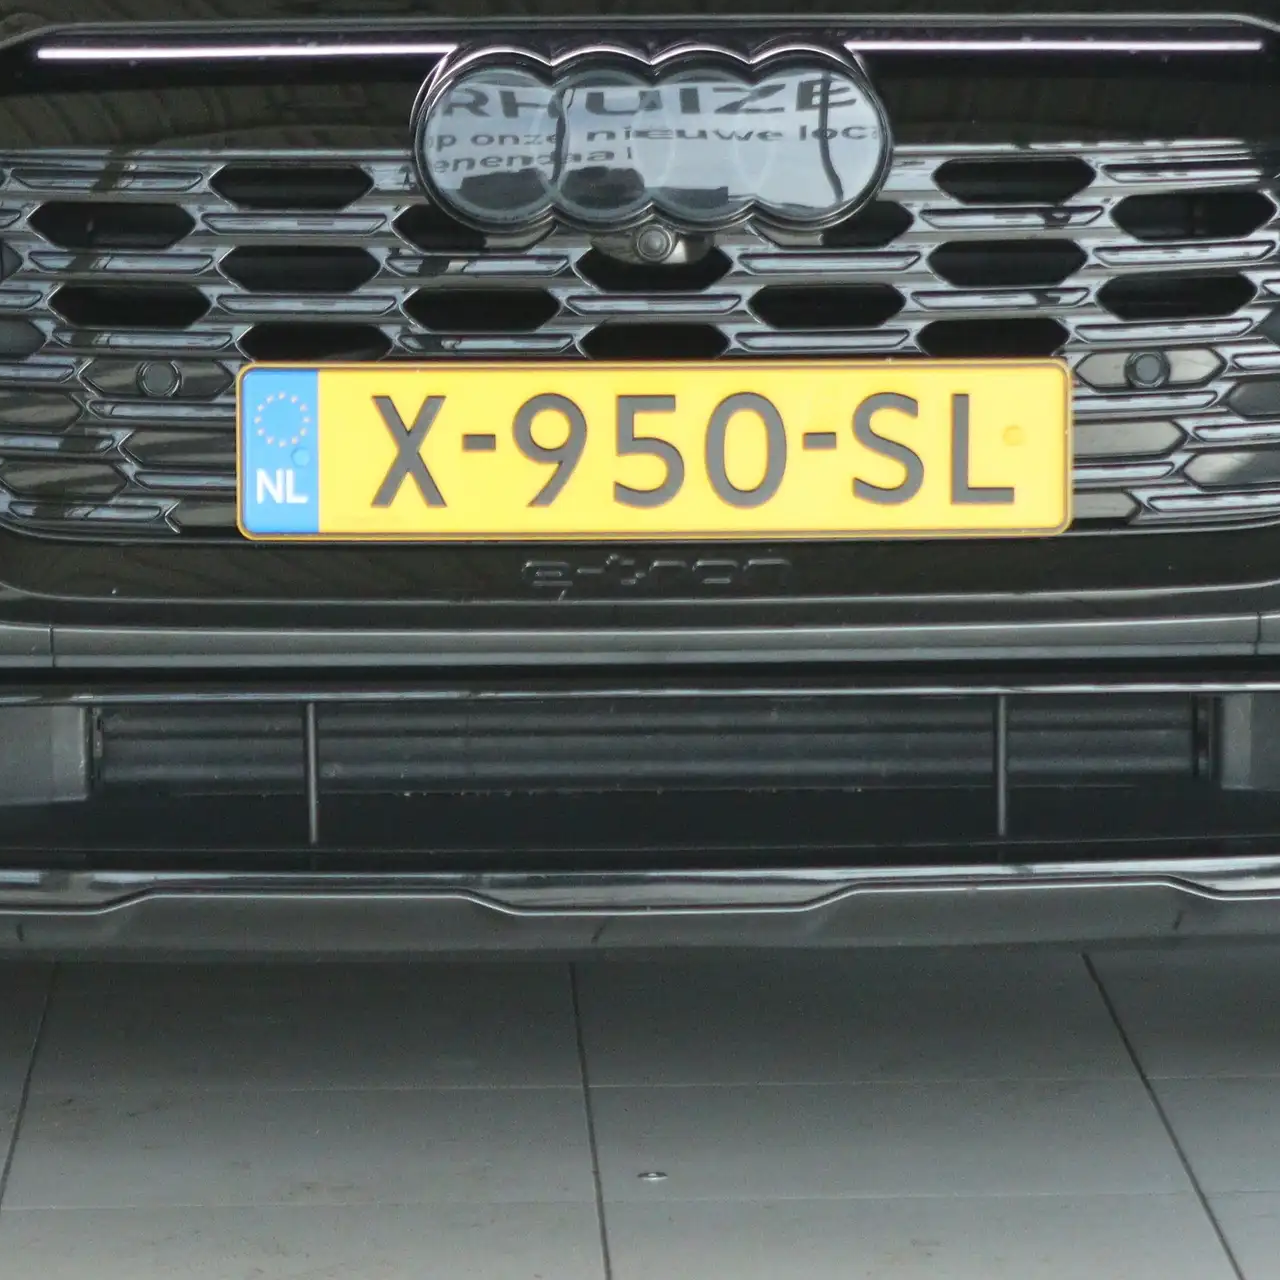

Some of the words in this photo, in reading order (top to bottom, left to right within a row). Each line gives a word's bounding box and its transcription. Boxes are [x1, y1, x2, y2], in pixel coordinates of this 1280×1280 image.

[429, 77, 857, 118] RHUIZE
[369, 391, 1017, 510] X-950-SL
[256, 467, 308, 505] NL
[521, 554, 792, 587] e-tron
